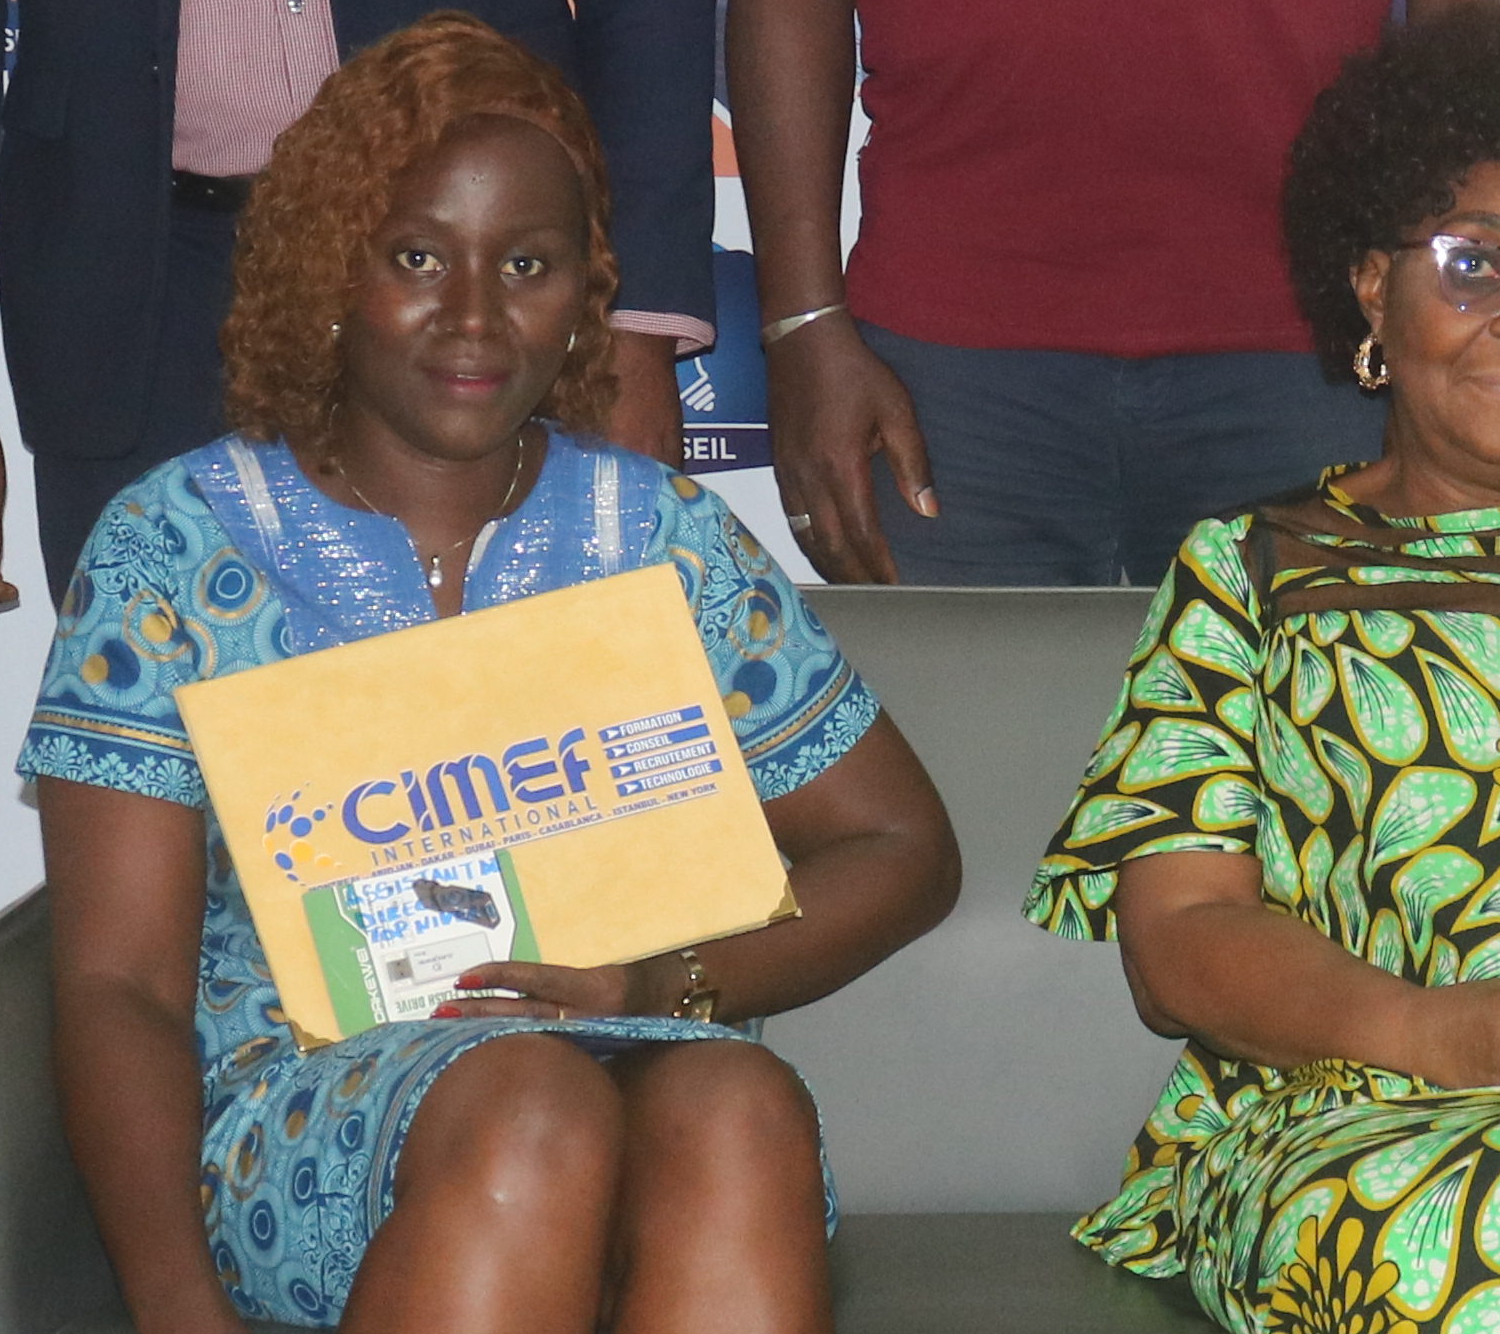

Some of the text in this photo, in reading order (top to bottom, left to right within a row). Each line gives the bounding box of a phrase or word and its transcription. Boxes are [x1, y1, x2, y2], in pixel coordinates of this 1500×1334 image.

[619, 712, 682, 737] FORMATION
[626, 734, 672, 755] CONSEIL
[634, 742, 713, 772] RECRUTEMENT
[638, 764, 714, 791] TECHNOLOGIE
[371, 796, 598, 866] INTERNATIONAL
[420, 851, 455, 867] DAKAR
[465, 841, 496, 855] DUBAI
[503, 831, 532, 845] PARIS
[538, 813, 604, 836] CASABLANCA
[612, 799, 661, 817] ISTANBUL
[667, 790, 689, 803] NEW
[691, 782, 718, 796] YORK
